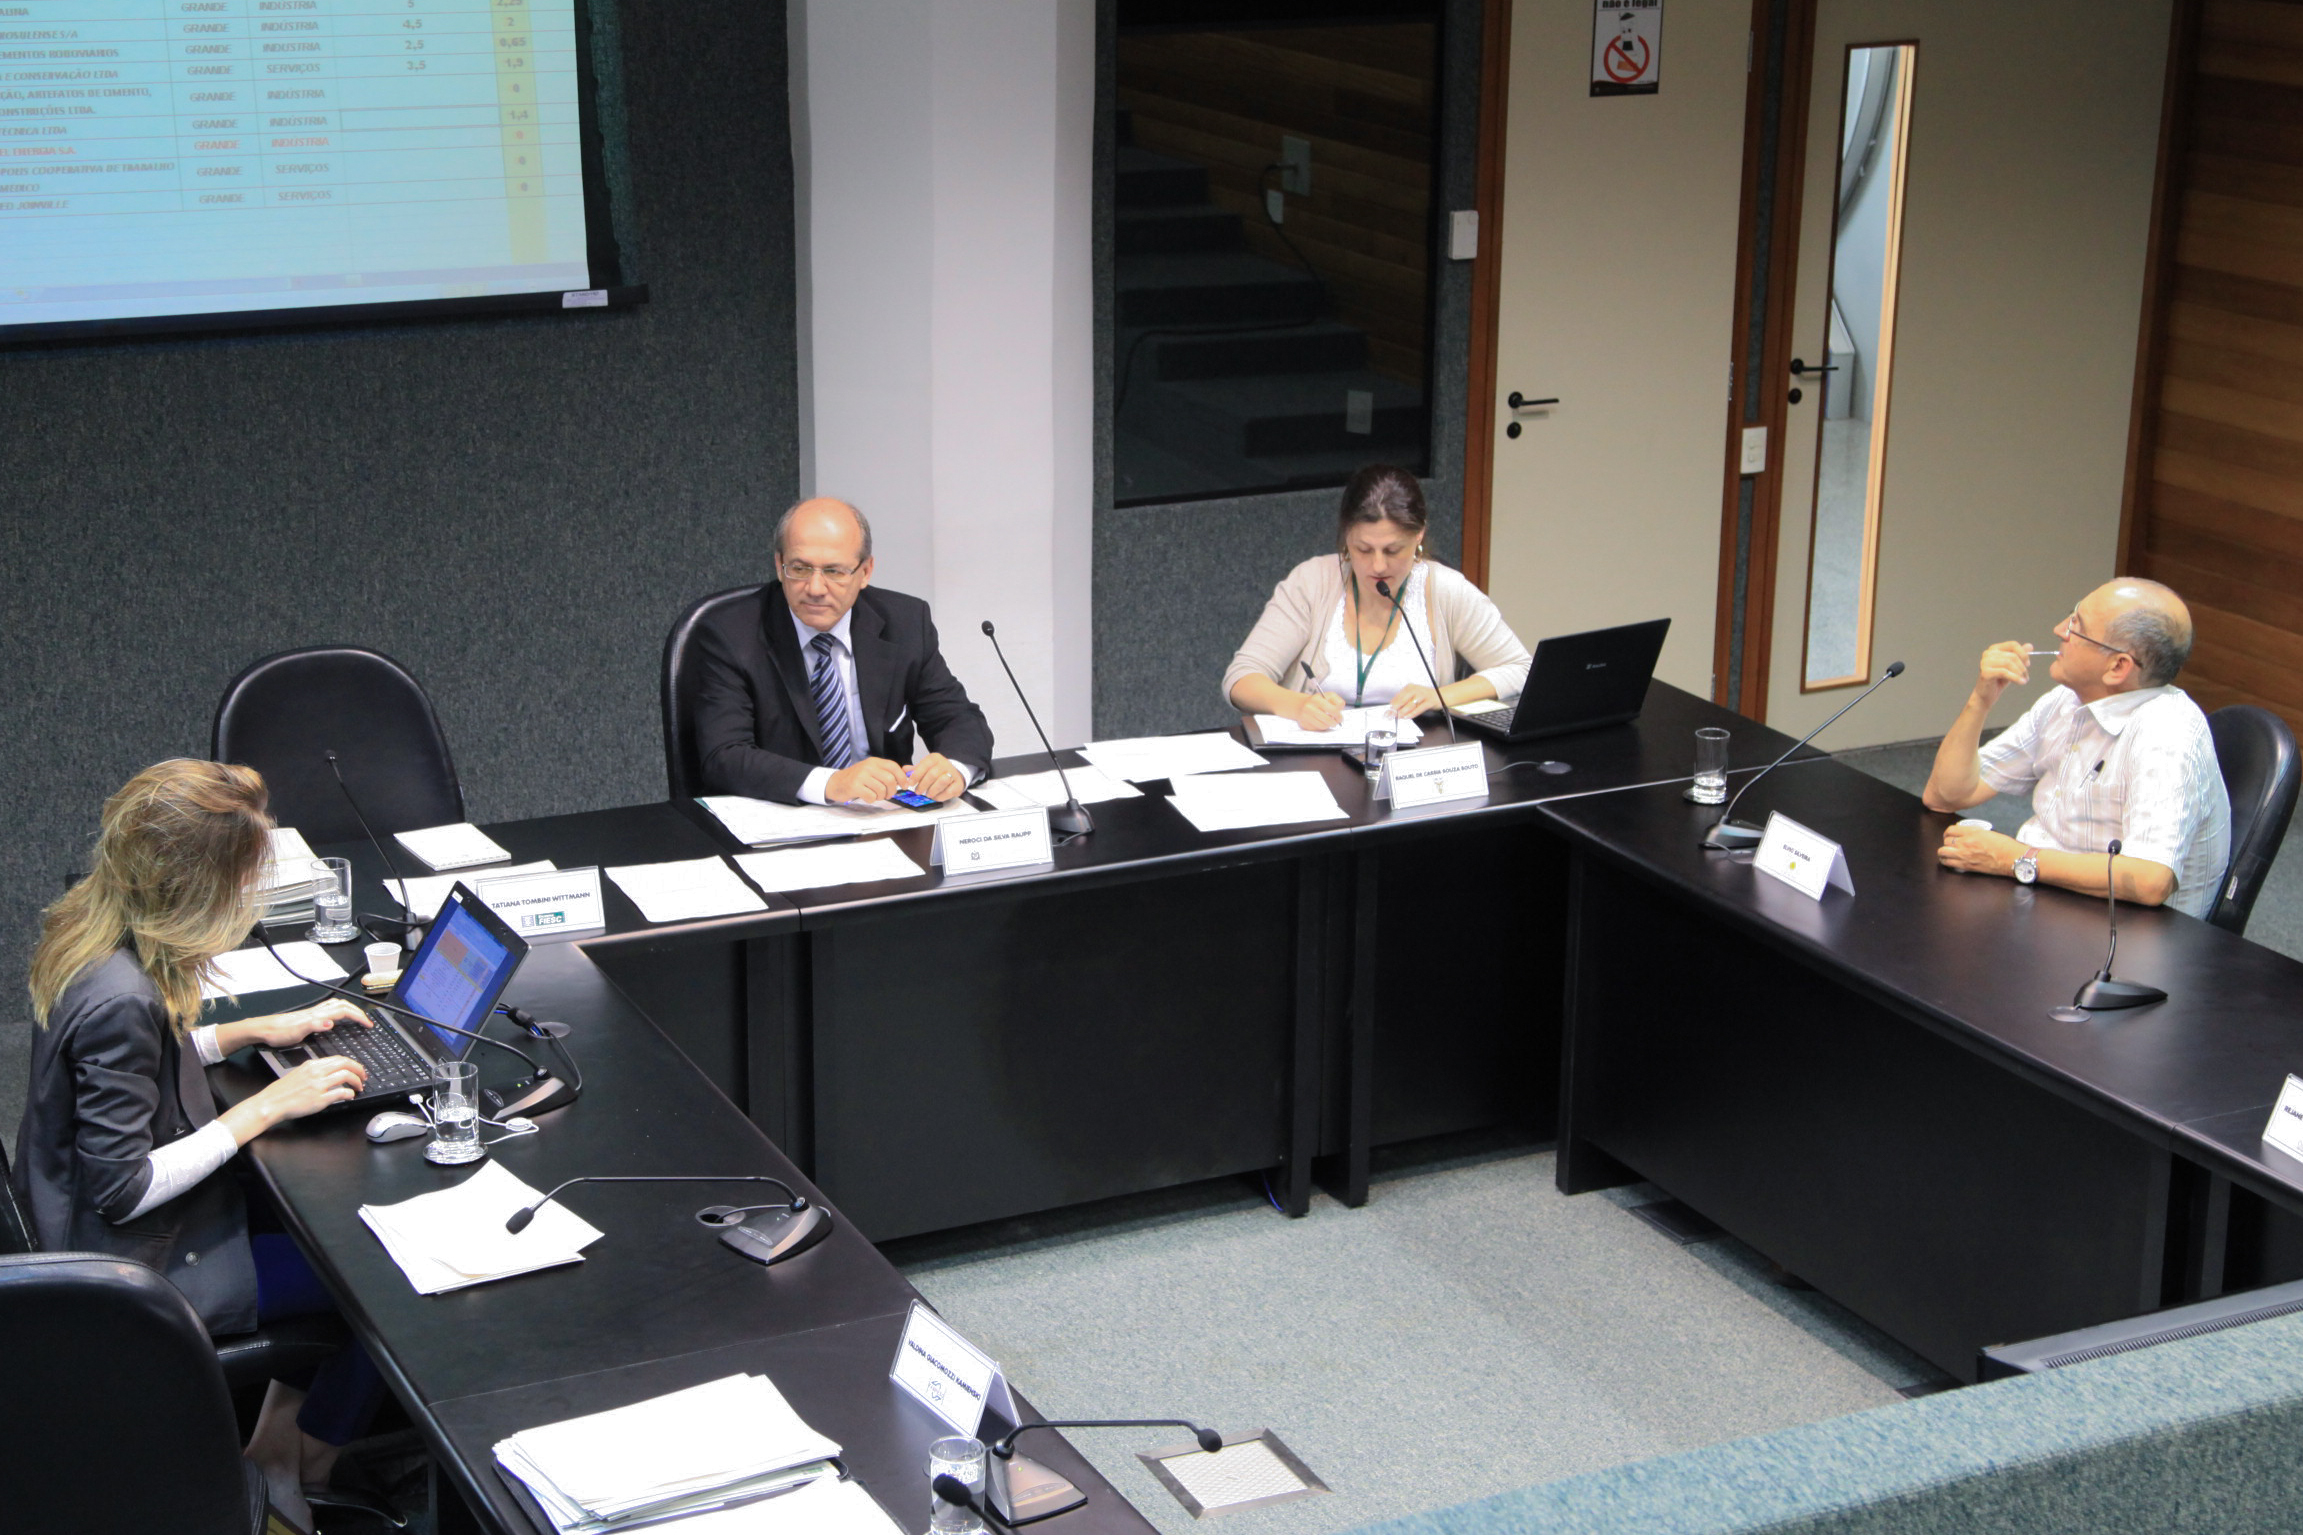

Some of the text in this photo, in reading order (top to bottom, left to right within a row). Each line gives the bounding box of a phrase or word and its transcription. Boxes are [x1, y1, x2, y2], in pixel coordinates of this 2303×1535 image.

[181, 2, 228, 12] GRANDE
[408, 0, 415, 8] 5
[261, 20, 319, 32] INDÚSTRIA
[402, 19, 423, 30] 4,5
[506, 17, 515, 27] 2
[183, 23, 230, 34] GRANDE
[185, 44, 232, 54] GRANDE
[405, 40, 424, 51] 2,5
[187, 65, 234, 75] GRANDE
[266, 63, 321, 74] SERVIÇOS
[407, 60, 427, 71] 3,5
[189, 91, 236, 102] GRANDE
[267, 88, 326, 100] INDÚSTRIA
[192, 118, 239, 129] GRANDE
[269, 115, 328, 127] INDÚSTRIA
[194, 140, 240, 151] GRANDE
[197, 166, 243, 177] GRANDE
[275, 162, 329, 175] SERVIÇOS
[199, 193, 245, 204] GRANDE
[278, 190, 332, 201] SERVIÇOS
[491, 892, 591, 909] TATIANA TOMBINI WITTMANN
[538, 916, 562, 925] FIESC
